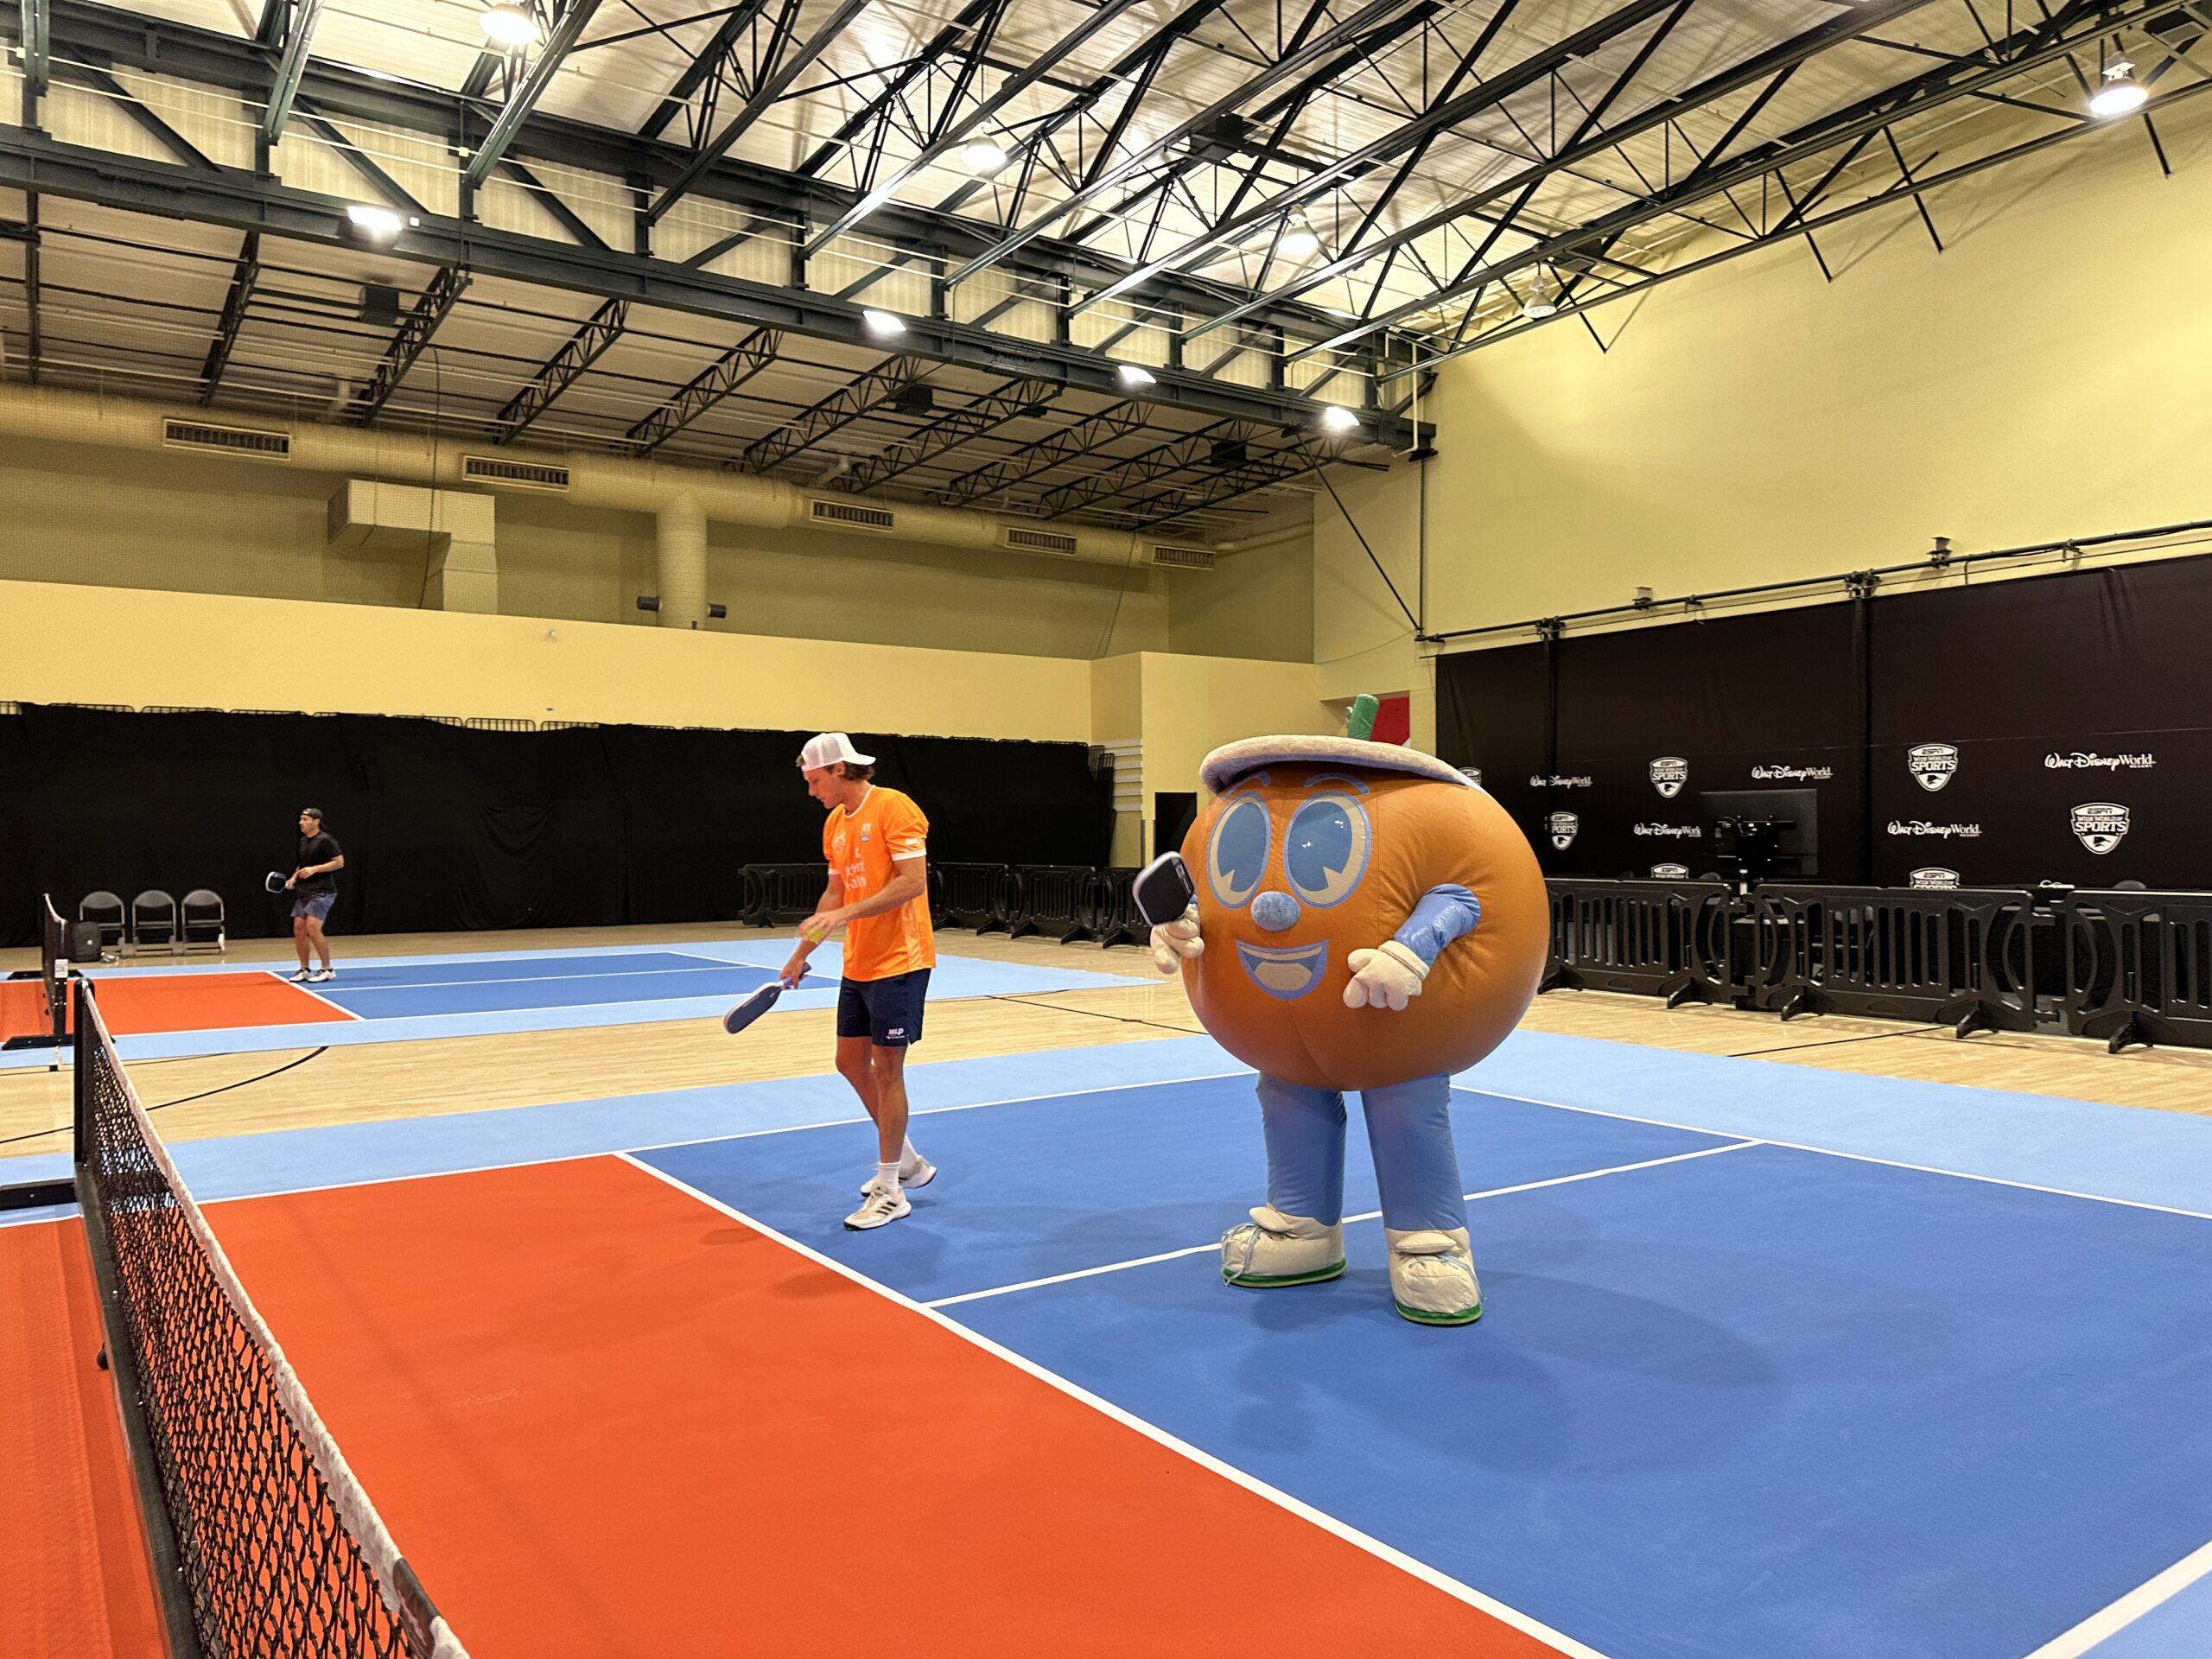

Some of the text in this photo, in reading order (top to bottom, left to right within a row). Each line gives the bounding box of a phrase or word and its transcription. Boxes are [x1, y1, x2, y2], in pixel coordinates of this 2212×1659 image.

[2119, 753, 2152, 766] World
[1805, 766, 1831, 777] World
[1910, 760, 1955, 772] SPORTS
[1652, 771, 1687, 781] SPORTS
[1950, 823, 1980, 834] World
[2074, 821, 2127, 832] SPORTS
